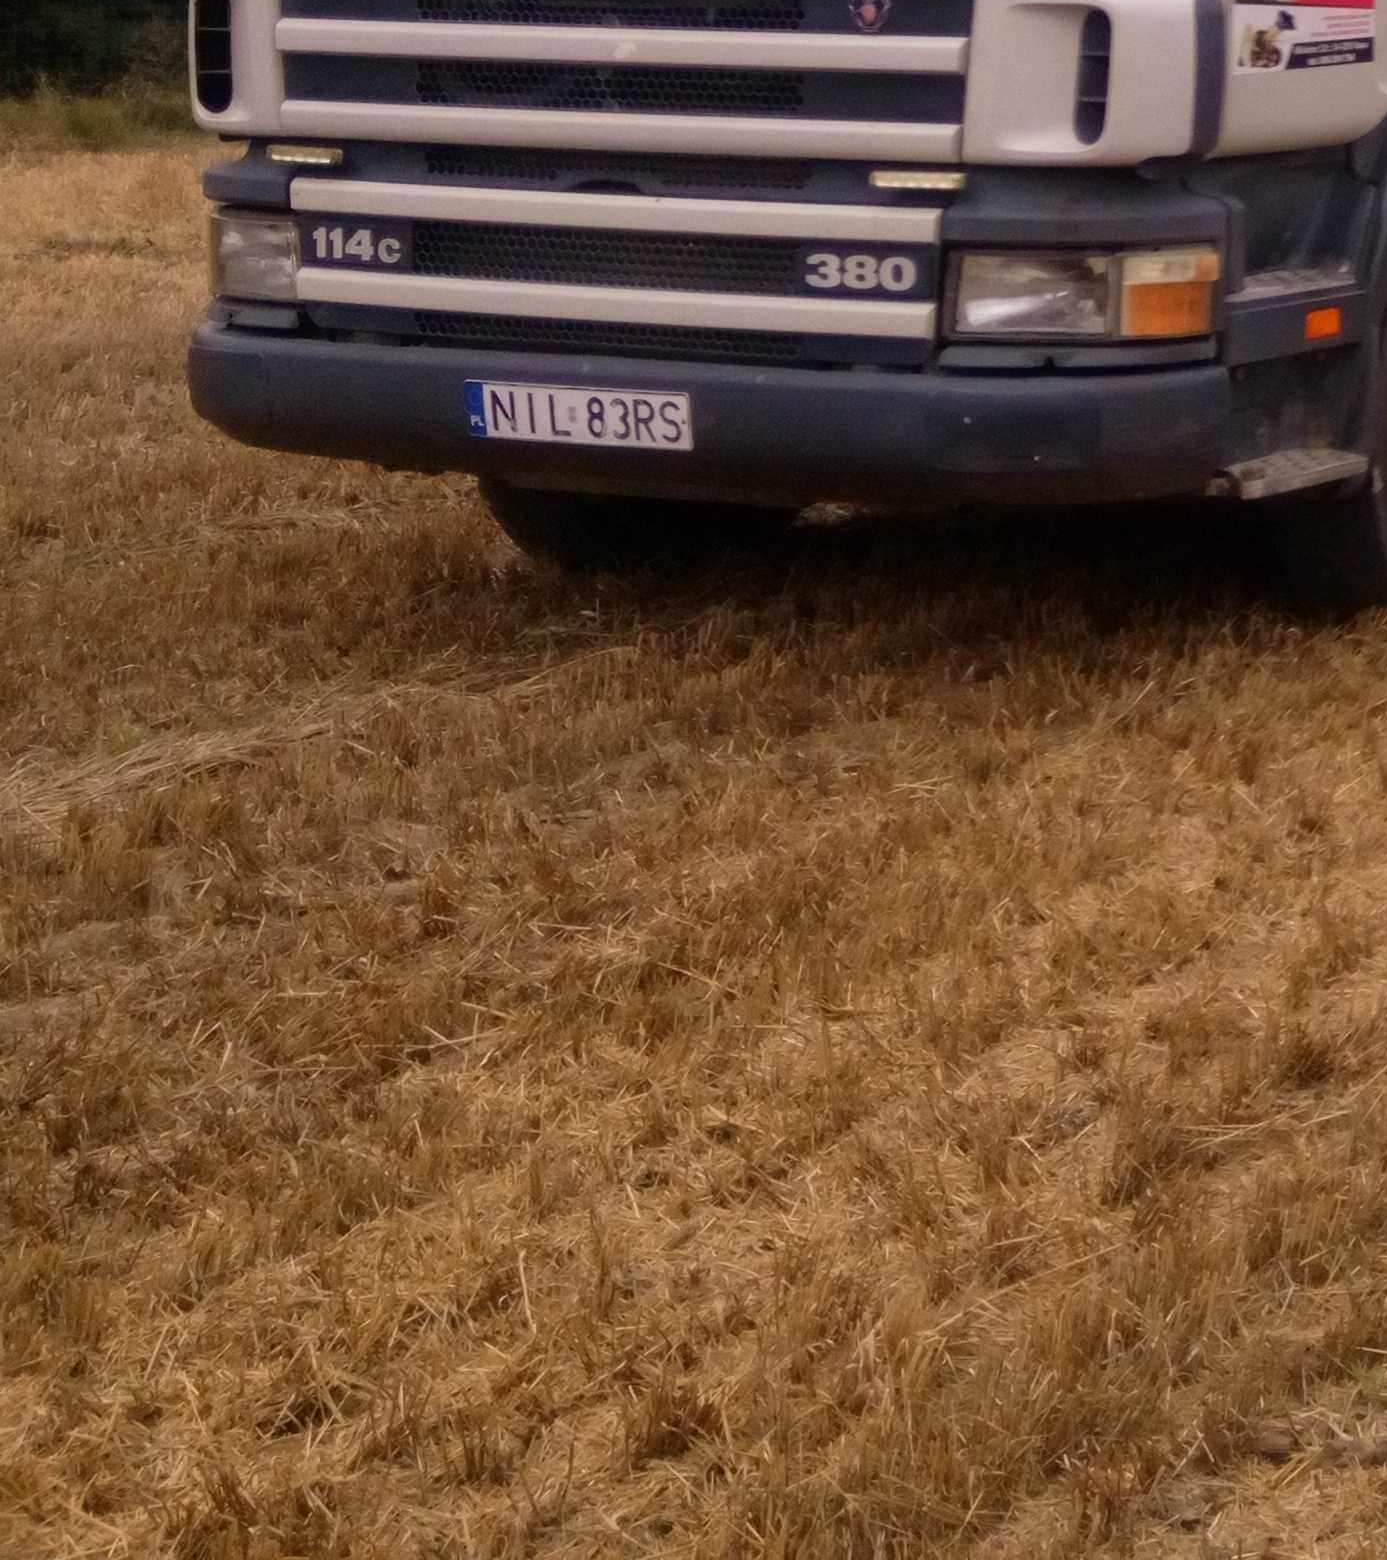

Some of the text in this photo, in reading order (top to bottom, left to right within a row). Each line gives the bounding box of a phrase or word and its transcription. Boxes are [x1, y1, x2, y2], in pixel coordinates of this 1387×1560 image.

[804, 253, 917, 291] 380
[490, 390, 572, 437] NIL
[586, 396, 682, 443] 83RS
